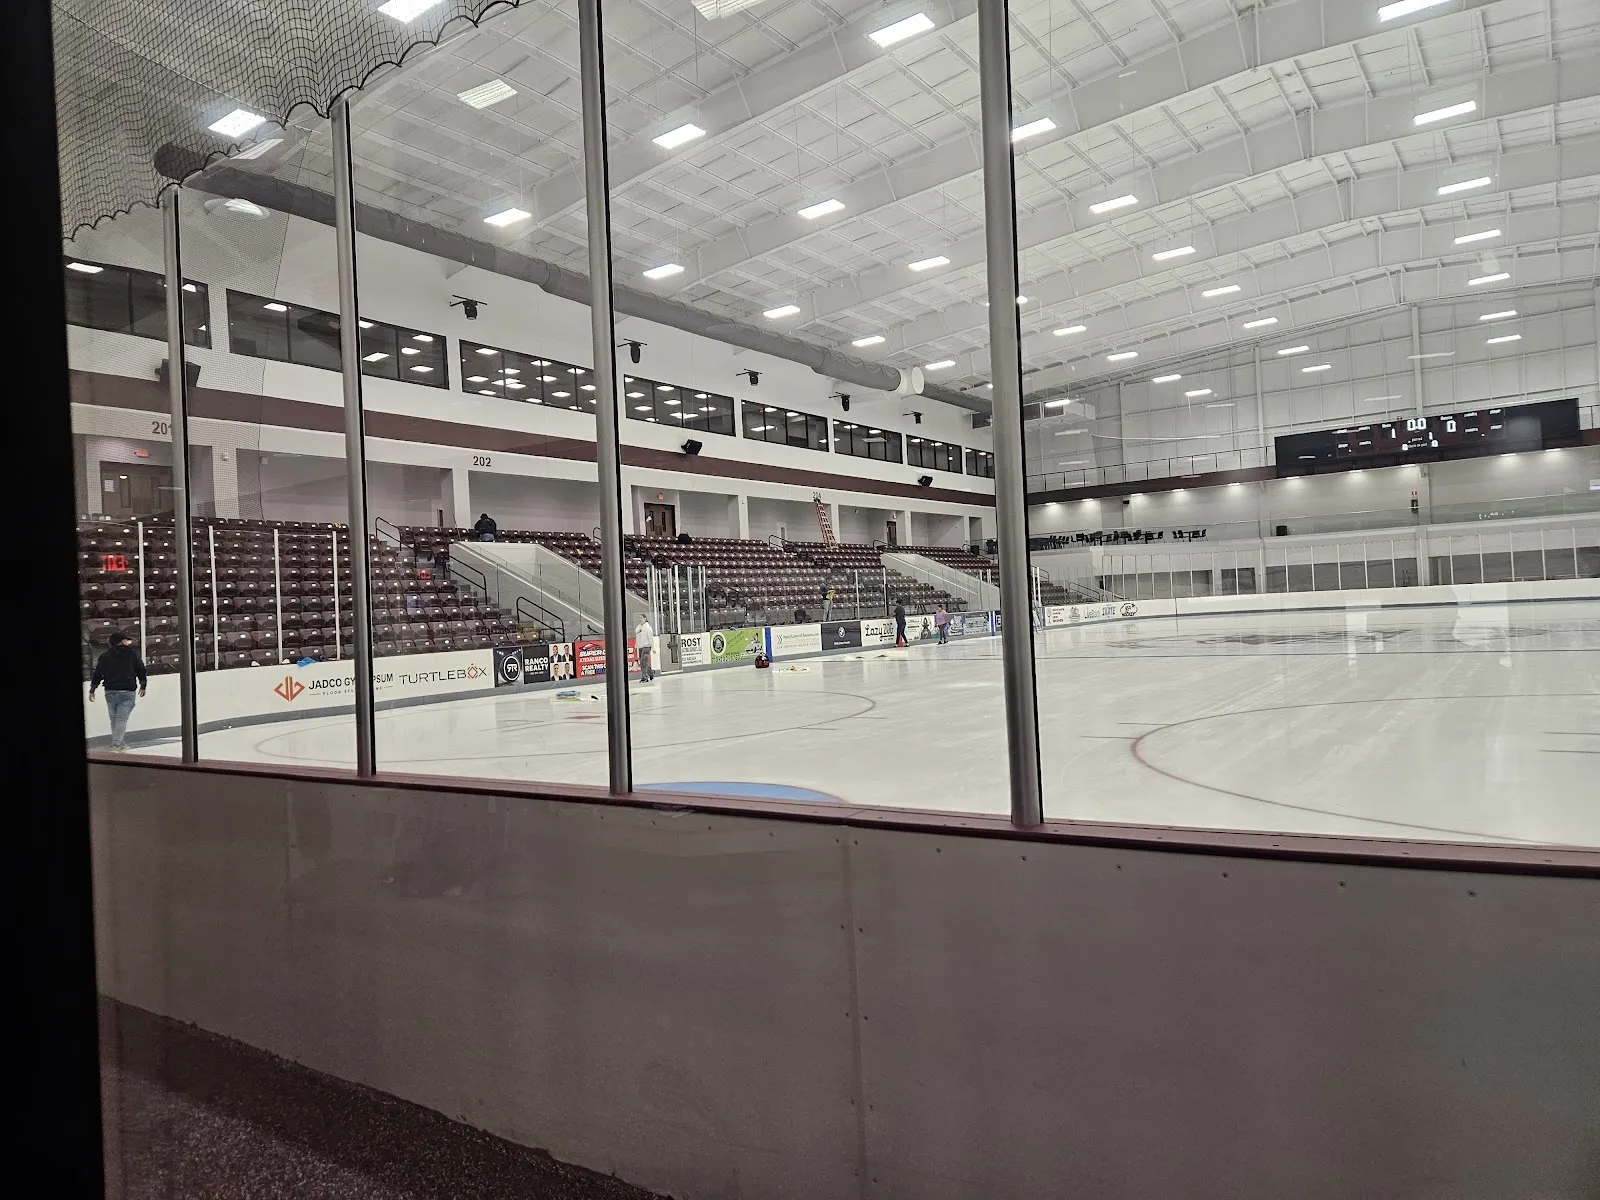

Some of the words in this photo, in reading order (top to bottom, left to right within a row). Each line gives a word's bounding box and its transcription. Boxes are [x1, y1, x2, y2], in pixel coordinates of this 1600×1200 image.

[1446, 420, 1457, 433] 0
[473, 455, 492, 467] 202
[524, 657, 548, 666] RANCO
[399, 664, 488, 685] TURTLEBOX
[524, 664, 549, 673] REALTY
[308, 678, 342, 690] JADCO
